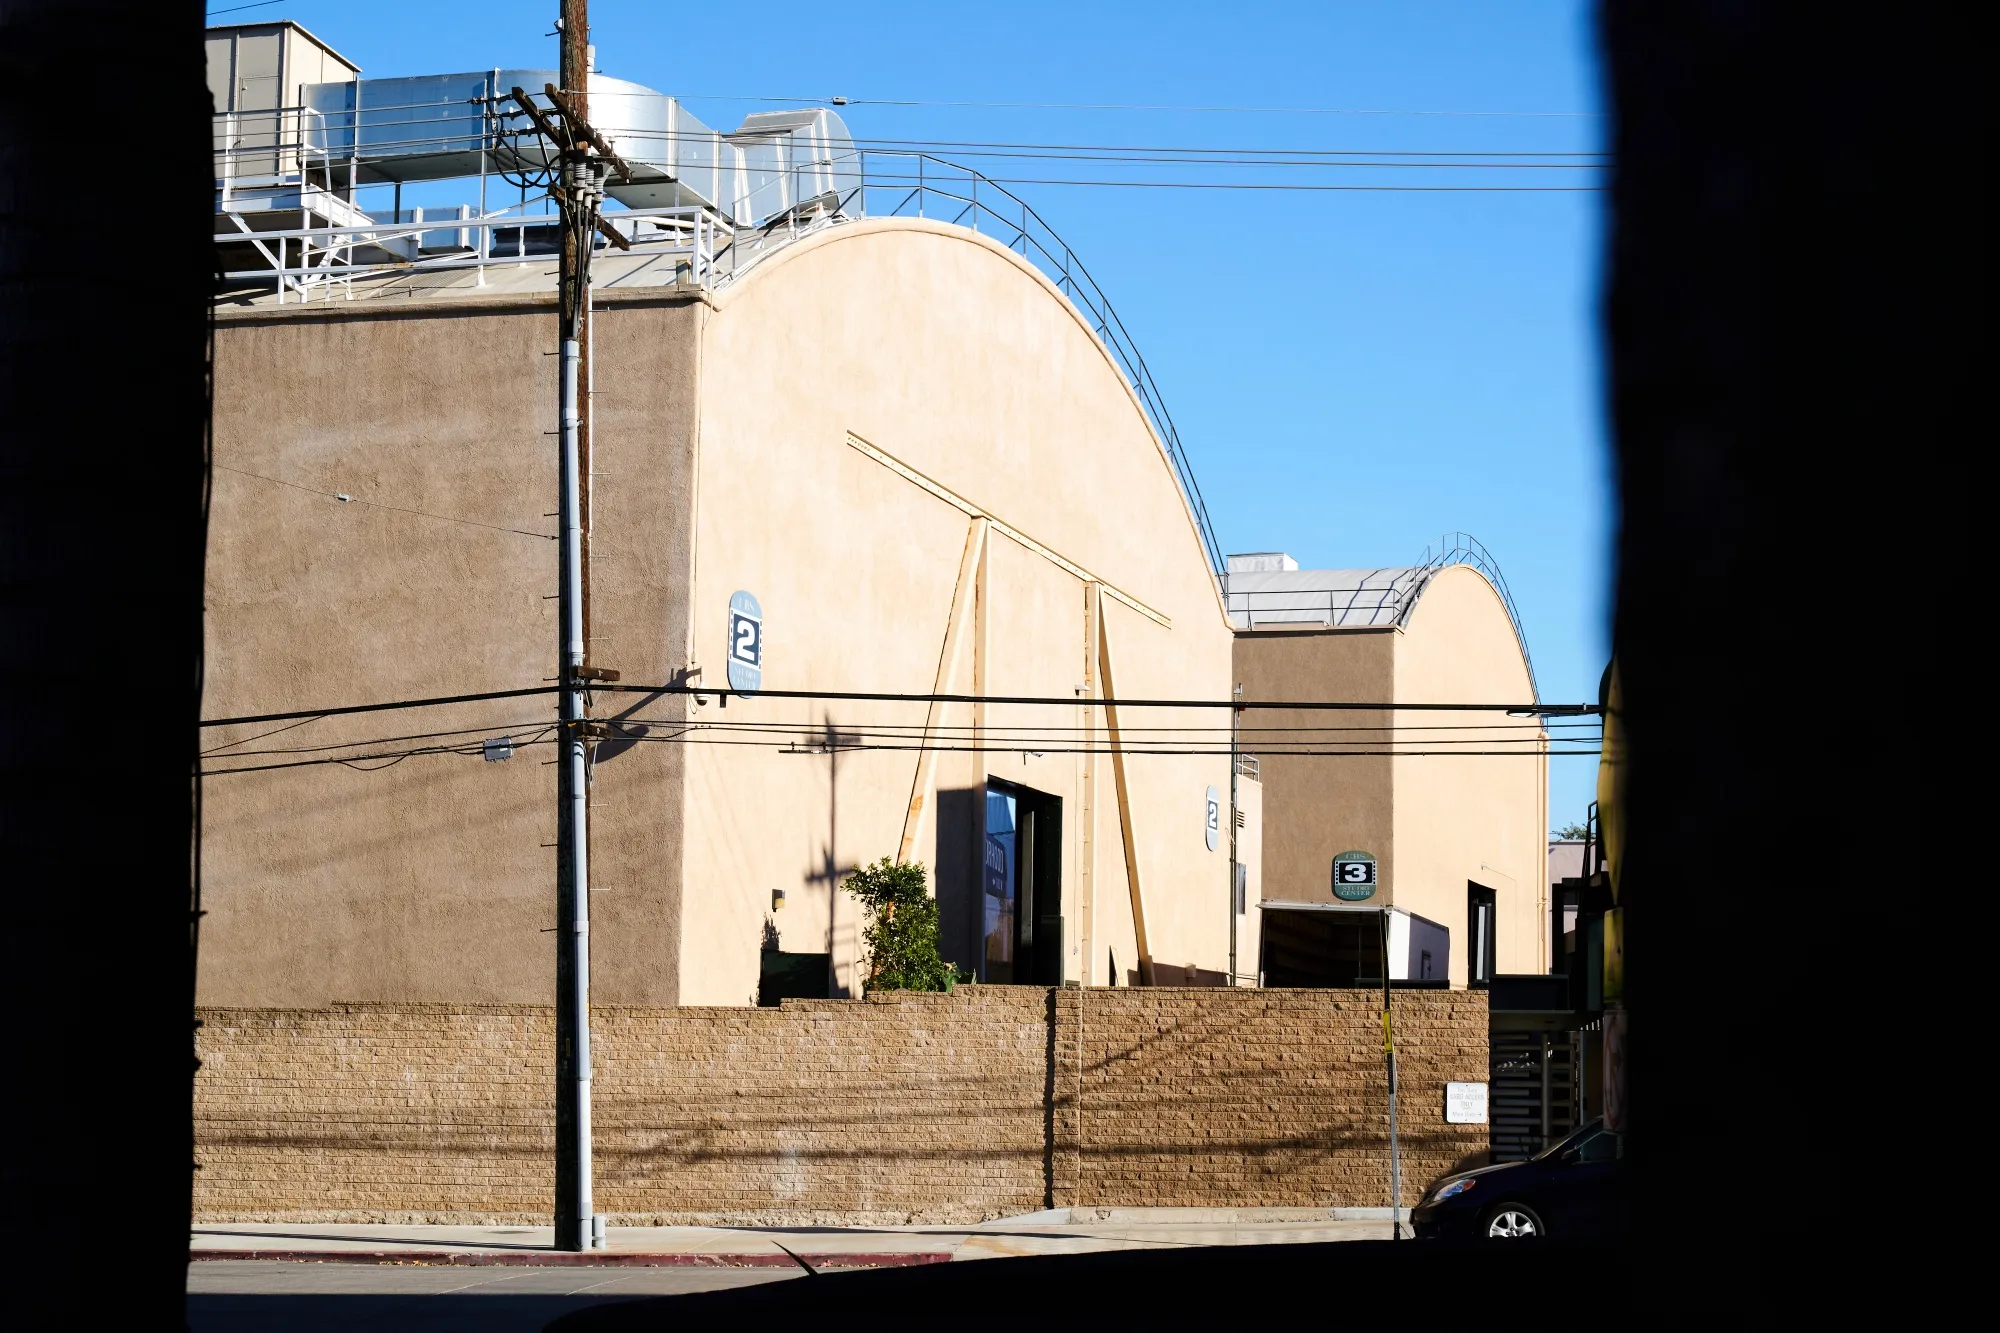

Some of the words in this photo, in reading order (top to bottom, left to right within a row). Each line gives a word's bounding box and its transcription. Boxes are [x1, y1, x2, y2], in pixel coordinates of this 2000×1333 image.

[738, 596, 755, 613] CBS
[736, 620, 756, 661] 2
[1209, 803, 1217, 828] 2
[1344, 863, 1367, 882] 3
